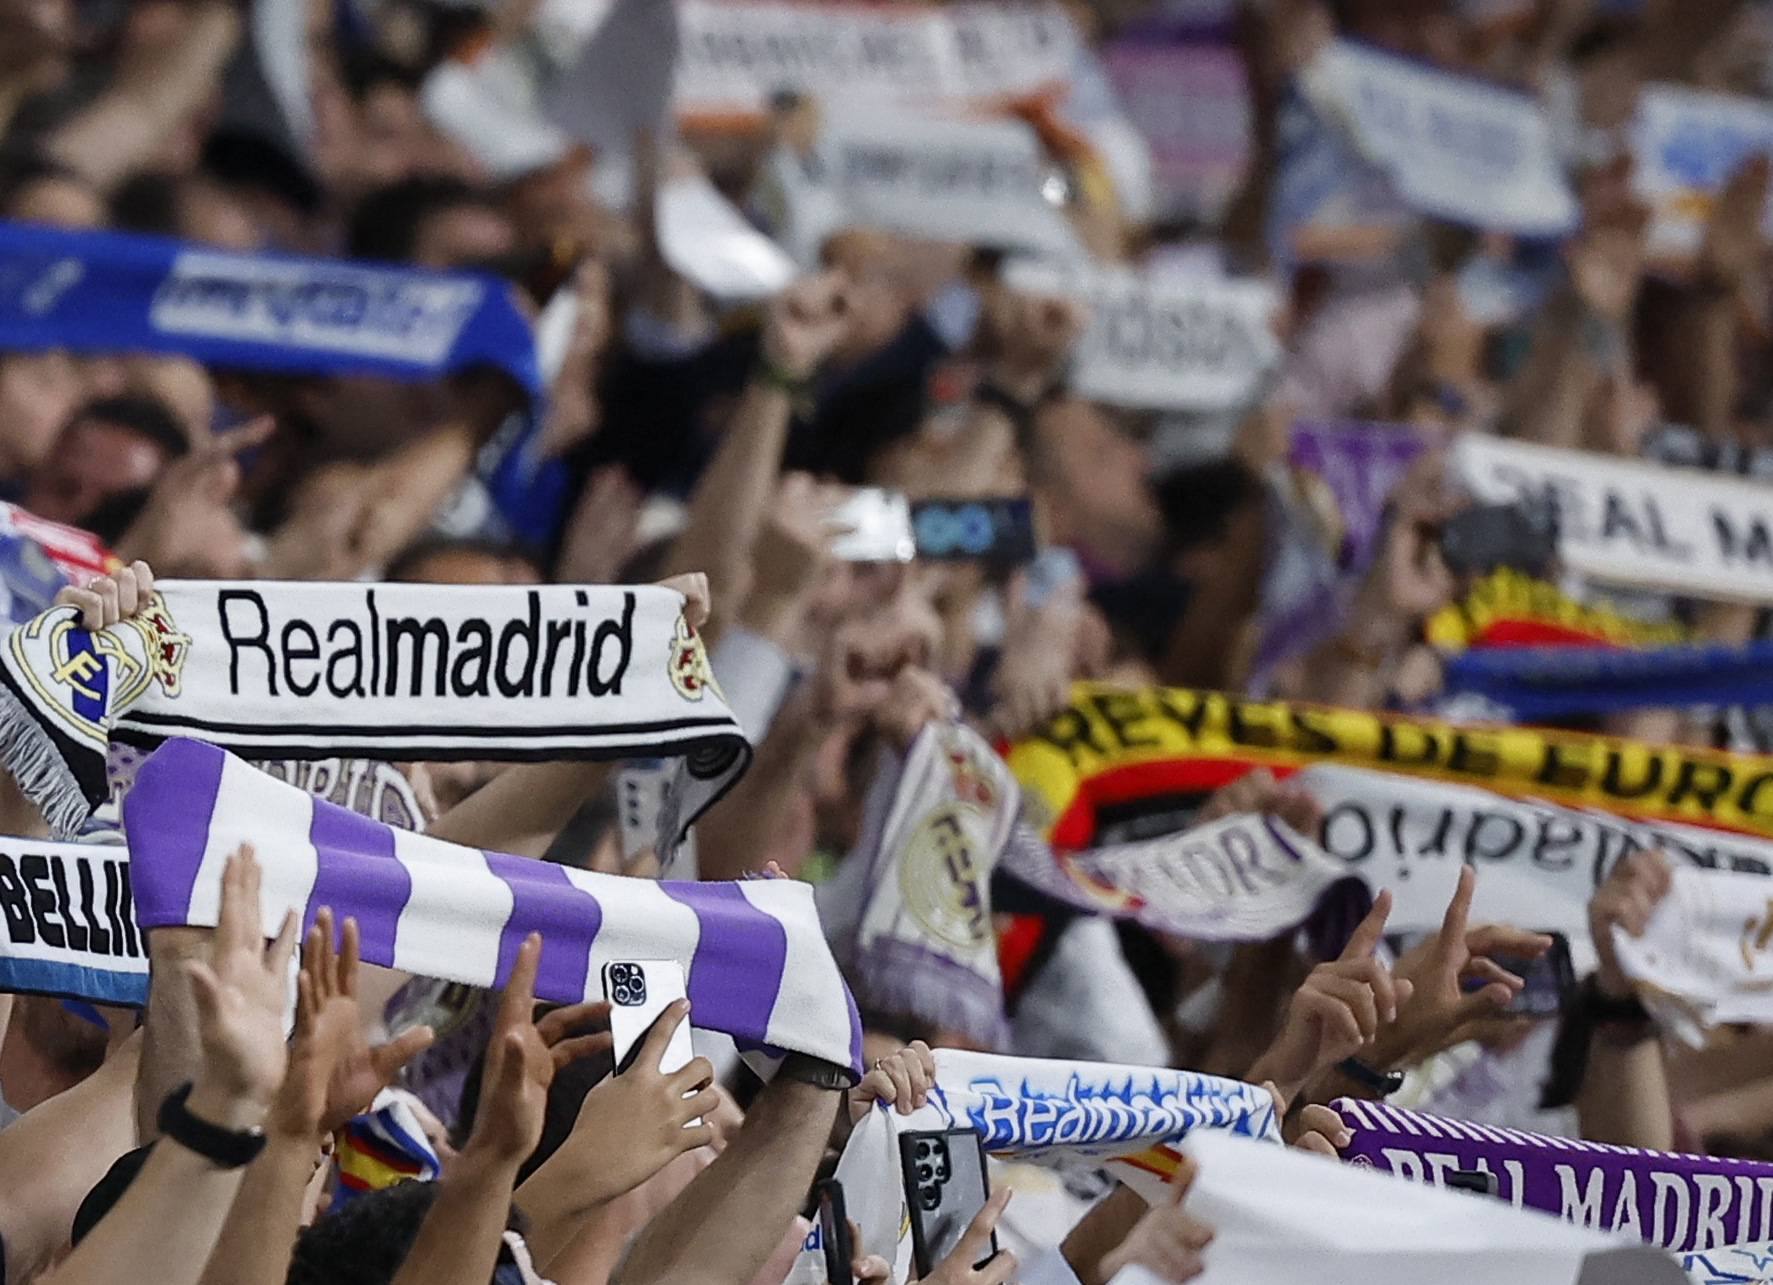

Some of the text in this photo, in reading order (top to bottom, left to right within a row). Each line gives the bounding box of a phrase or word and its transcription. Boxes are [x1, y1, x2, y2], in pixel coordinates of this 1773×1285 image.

[219, 588, 635, 700] Realmadrid
[1033, 690, 1339, 762] REYES
[1379, 722, 1503, 780] DE
